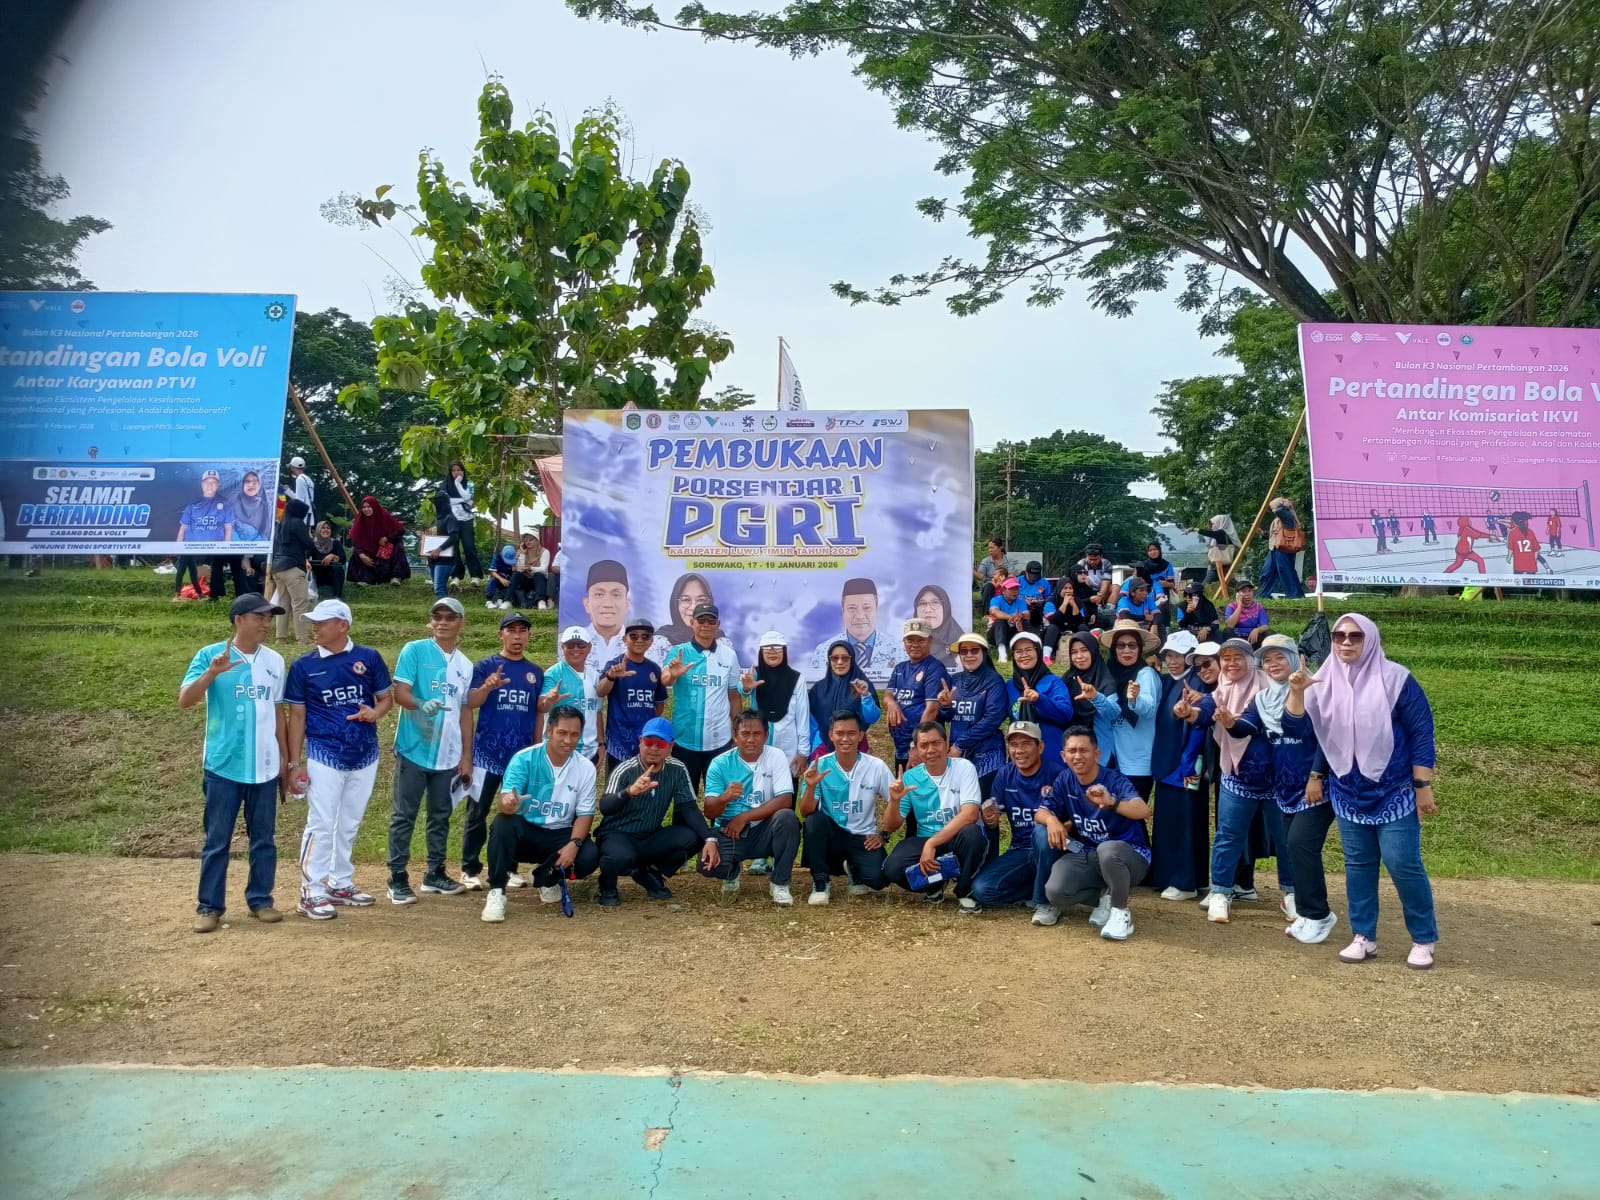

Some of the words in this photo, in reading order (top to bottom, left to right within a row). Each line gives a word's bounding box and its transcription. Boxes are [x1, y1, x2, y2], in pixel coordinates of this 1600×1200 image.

[51, 329, 63, 337] K3
[64, 329, 105, 338] Nasional
[106, 330, 175, 339] Pertambangan
[176, 330, 199, 338] 2026
[147, 347, 208, 368] Bola
[217, 346, 268, 368] Voli
[1395, 361, 1420, 369] Bulan
[1423, 362, 1434, 370] K3
[1436, 362, 1474, 371] Nasional
[1477, 363, 1545, 374] Pertambangan
[14, 376, 64, 389] Antar
[67, 376, 153, 392] Karyawan
[156, 376, 196, 389] PTVI
[1329, 376, 1515, 406] Pertandingan
[1524, 380, 1582, 402] Bola
[1396, 408, 1444, 422] Antar
[1448, 408, 1539, 422] Komisariat
[1542, 410, 1578, 424] IKVI
[1362, 436, 1422, 446] Pertambangan
[1460, 440, 1480, 448] yang
[1531, 439, 1554, 447] Andal
[1556, 440, 1572, 448] dan
[1540, 430, 1592, 438] Keselamatan
[647, 437, 885, 470] PEMBUKAAN
[672, 474, 844, 498] PORSENIJAR
[850, 475, 863, 495] 1
[45, 486, 136, 504] SELAMAT
[16, 504, 150, 526] BERTANDING
[664, 495, 866, 548] PGRI
[670, 547, 729, 556] KABUPATEN
[730, 547, 760, 556] LUWU
[762, 547, 796, 556] TIMUR
[798, 547, 829, 556] TAHUN
[830, 546, 858, 556] 2026
[1517, 540, 1532, 552] 12
[692, 562, 745, 571] SOROWAKO,
[748, 562, 757, 570] 17
[765, 562, 775, 570] 19
[776, 561, 816, 570] JANUARI
[818, 561, 839, 570] 2026
[432, 680, 458, 697] PGRI
[691, 674, 722, 687] PGRI
[236, 684, 271, 700] PGRI
[321, 684, 364, 704] PGRI
[498, 689, 530, 704] PGRI
[627, 688, 656, 702] PGRI
[951, 700, 977, 714] PGRI
[528, 799, 570, 818] PGRI
[832, 800, 864, 814] PGRI
[926, 806, 958, 823] PGRI
[1073, 813, 1108, 832] PGRI
